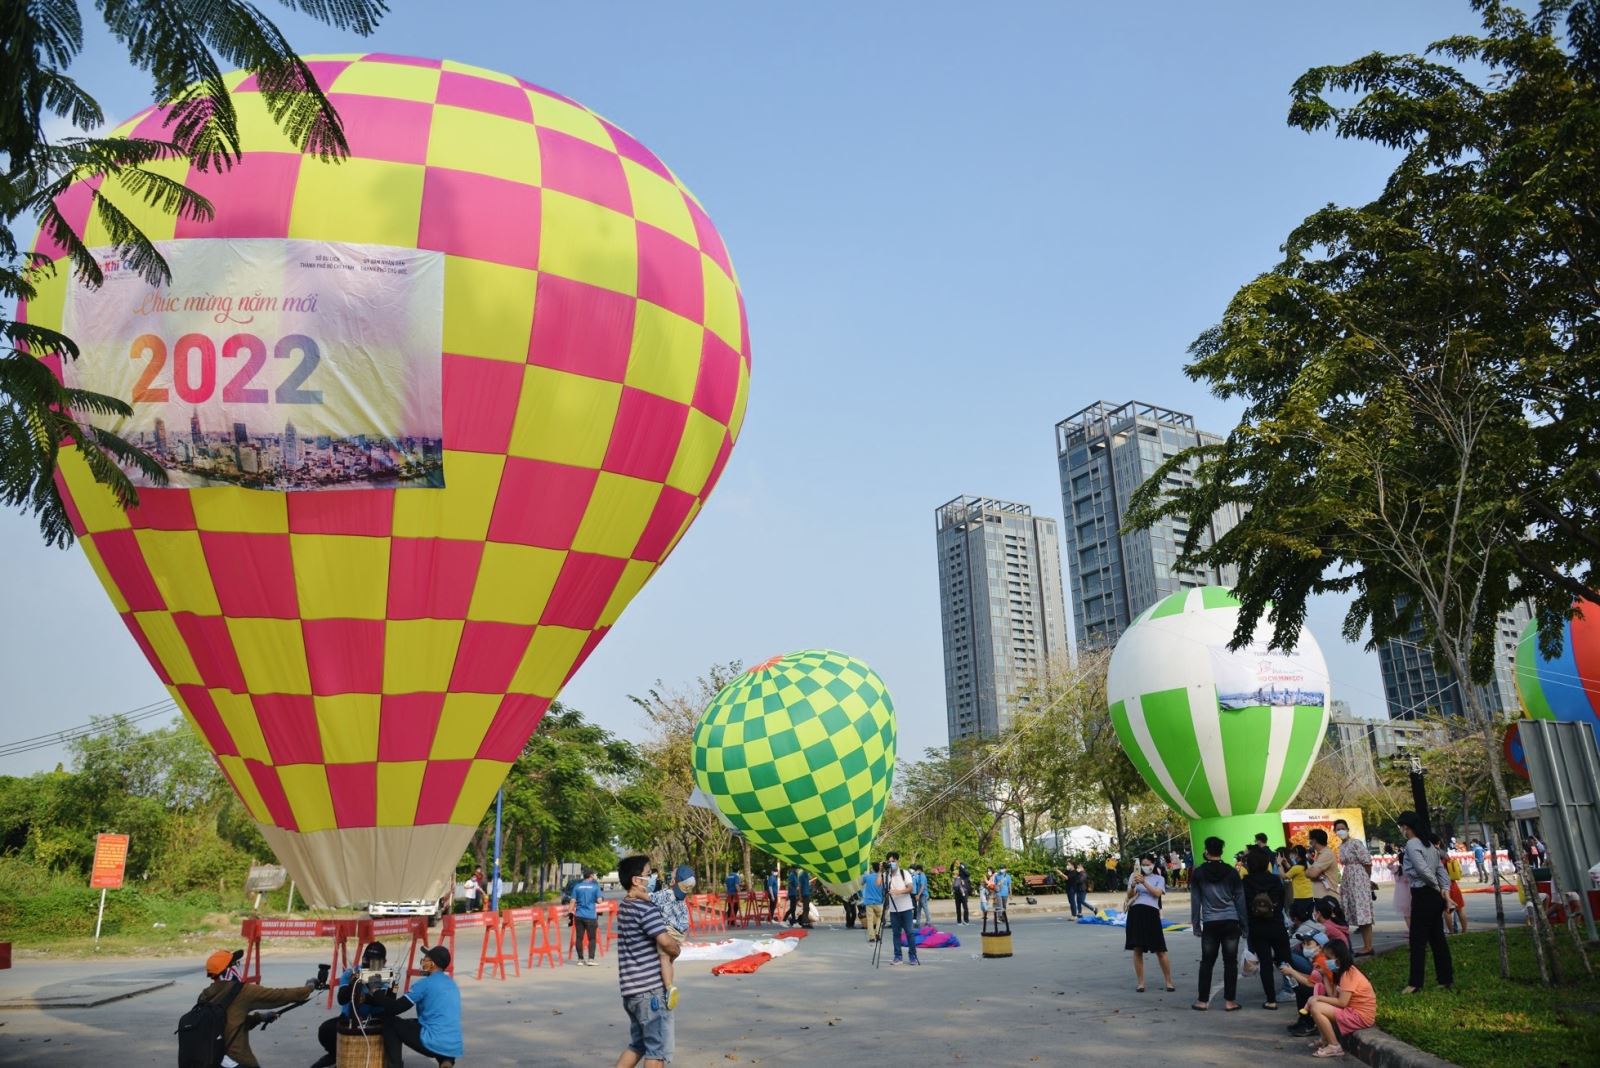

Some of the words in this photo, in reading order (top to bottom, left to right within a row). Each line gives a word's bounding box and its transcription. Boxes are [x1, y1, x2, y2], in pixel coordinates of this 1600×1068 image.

[133, 287, 179, 316] Chúc
[184, 292, 254, 325] mừng
[238, 292, 278, 312] năm
[282, 293, 319, 313] mới
[130, 333, 322, 404] 2022
